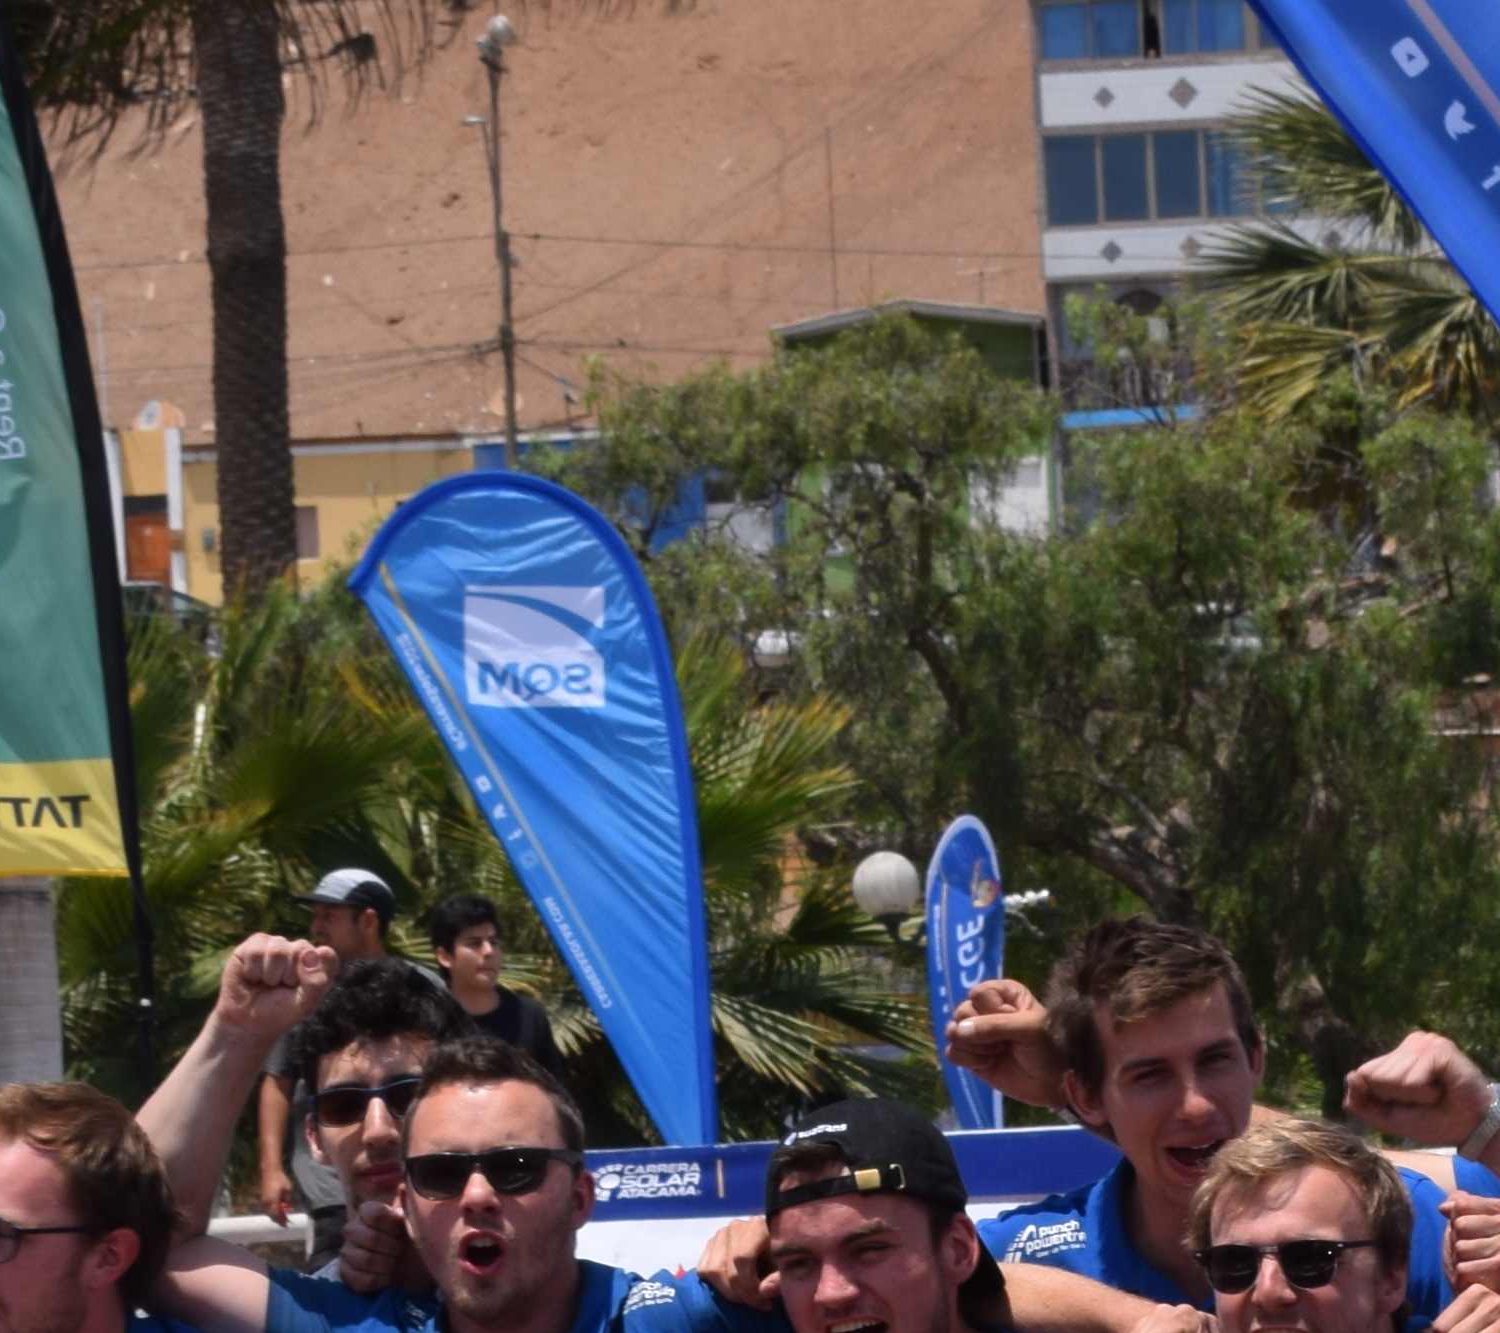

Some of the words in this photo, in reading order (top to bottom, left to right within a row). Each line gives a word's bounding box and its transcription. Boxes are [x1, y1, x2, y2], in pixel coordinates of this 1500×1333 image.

[621, 1162, 700, 1174] CARRERA
[618, 1173, 700, 1187] SOLAR
[615, 1186, 696, 1198] ATACAMA
